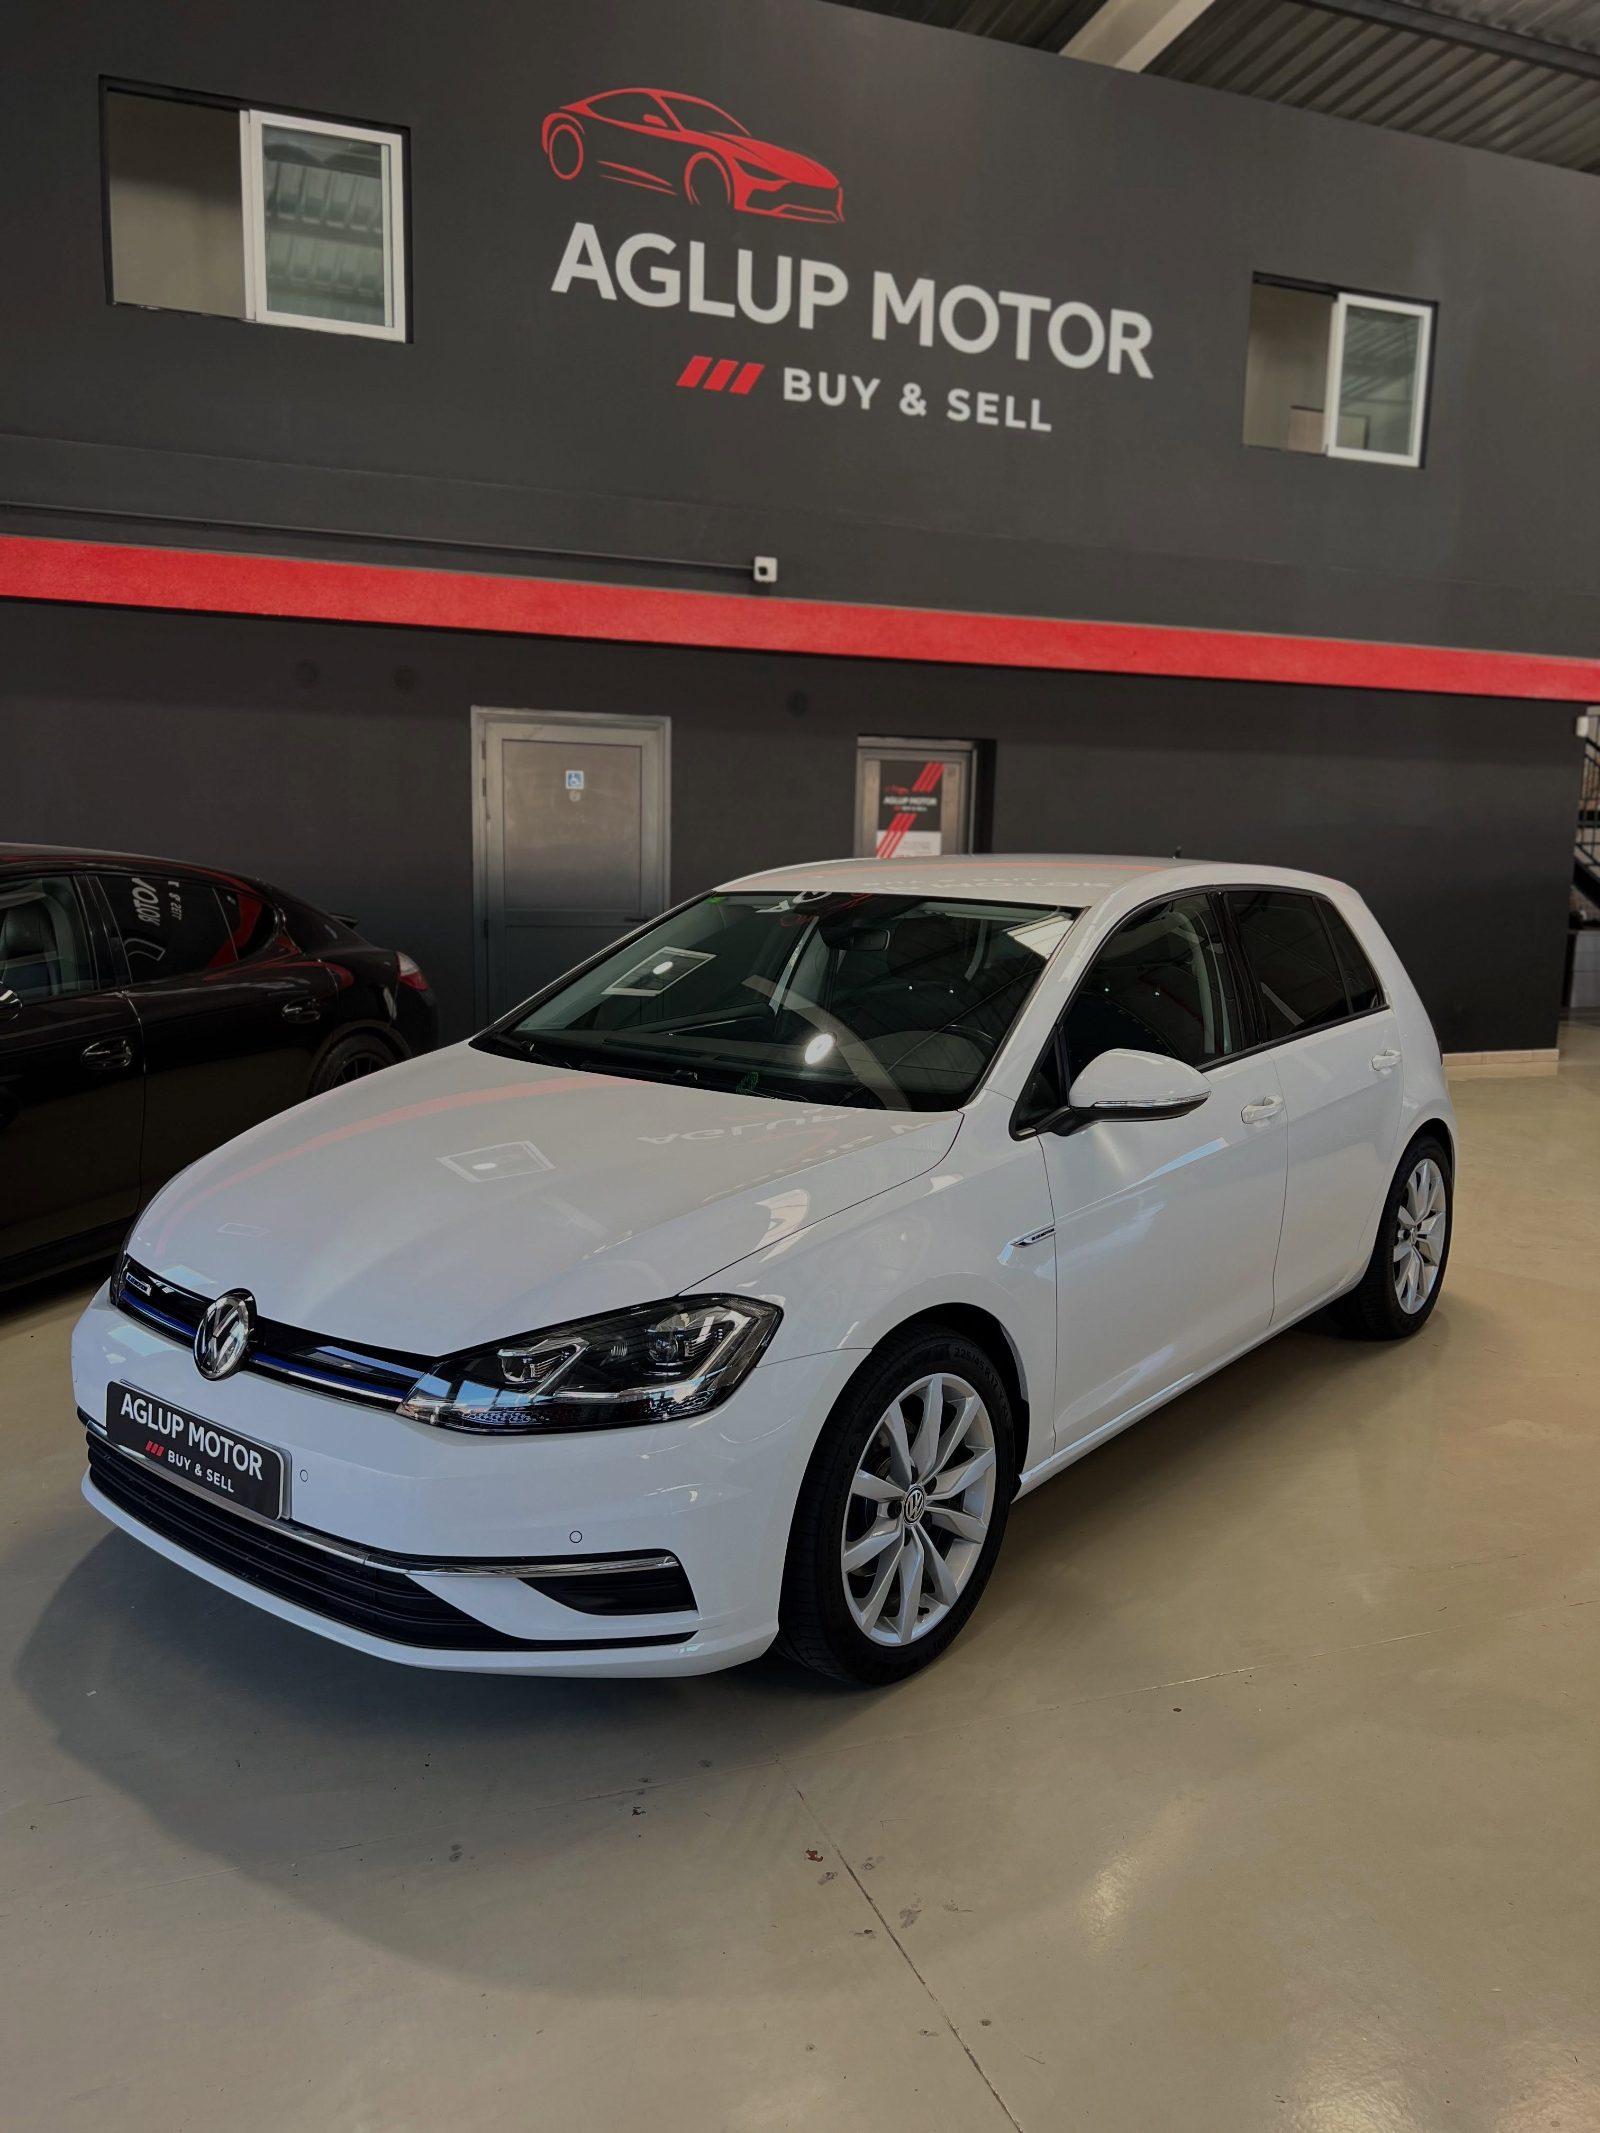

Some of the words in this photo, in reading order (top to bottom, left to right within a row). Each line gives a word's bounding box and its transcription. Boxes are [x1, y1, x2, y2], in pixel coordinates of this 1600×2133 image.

[551, 221, 849, 330] AGLUP
[871, 270, 1155, 380] MOTOR
[783, 367, 880, 411] BUY
[899, 383, 928, 418] &
[946, 388, 1052, 432] SELL
[120, 1392, 185, 1439] AGLUP
[188, 1421, 263, 1481] MOTOR
[167, 1449, 192, 1471] BUY
[194, 1462, 203, 1477] &
[206, 1467, 235, 1493] SELL
